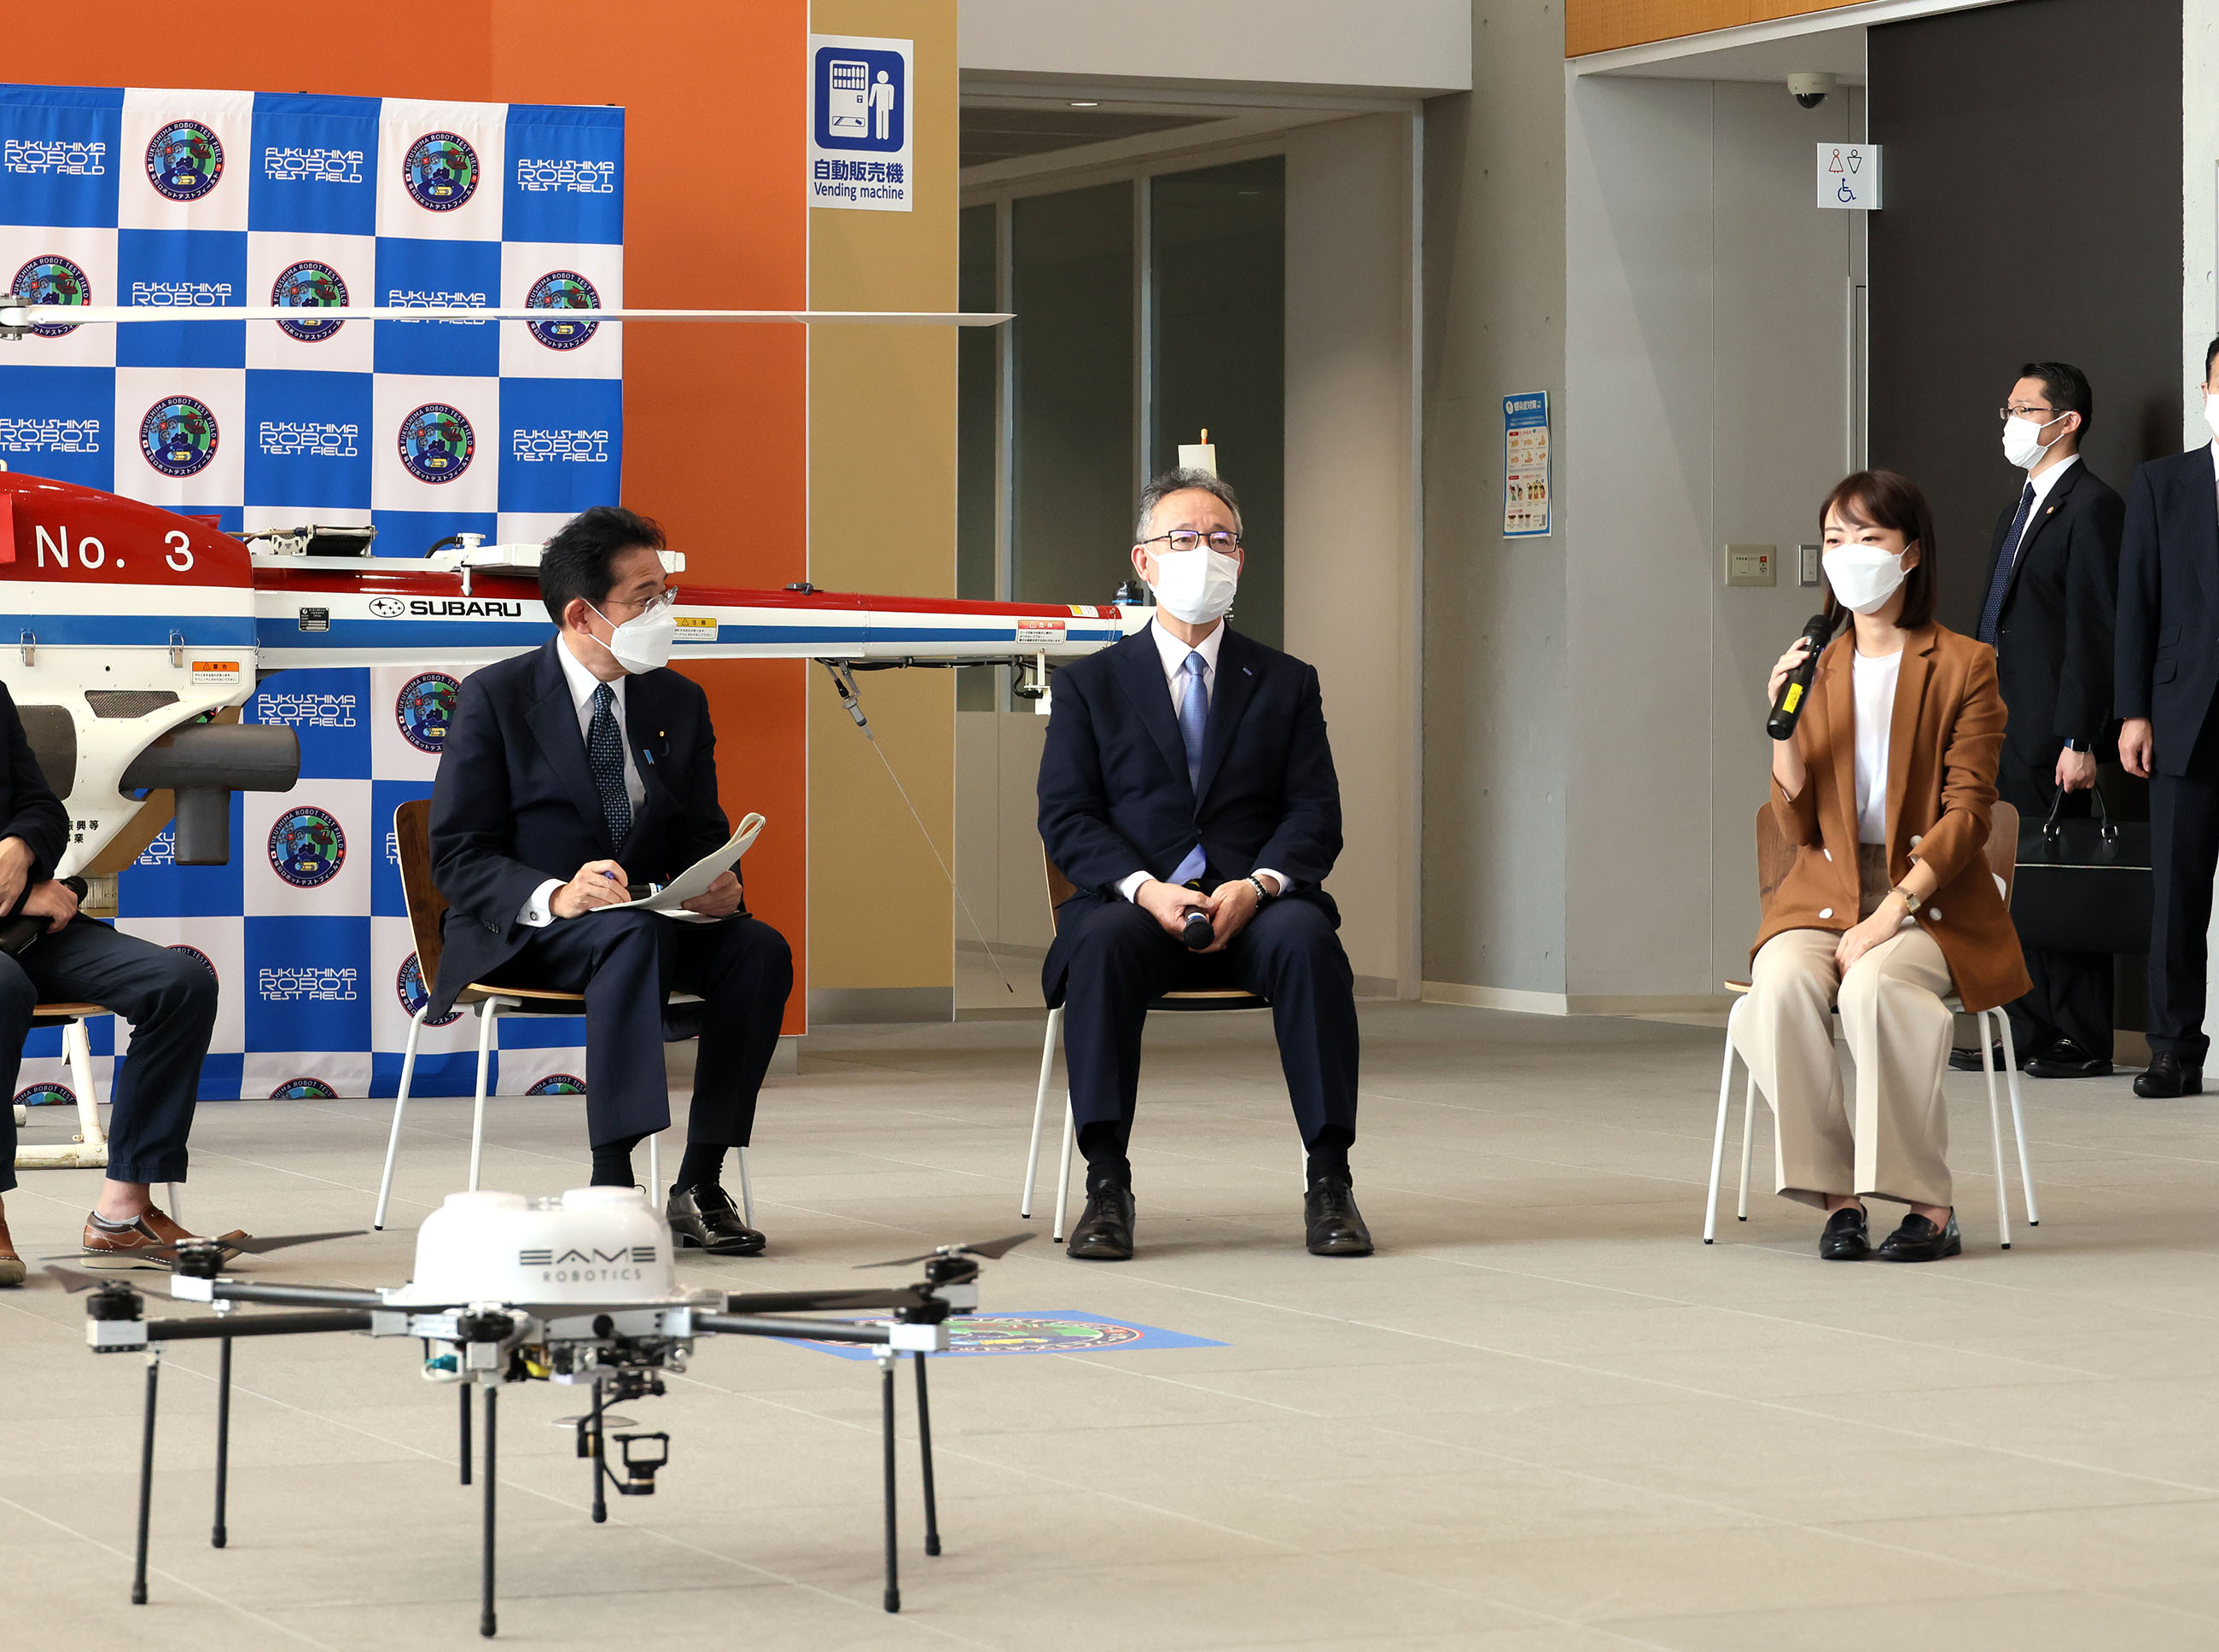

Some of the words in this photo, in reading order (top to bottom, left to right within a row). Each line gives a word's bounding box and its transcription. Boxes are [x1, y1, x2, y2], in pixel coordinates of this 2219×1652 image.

[5, 140, 106, 152] FUKUSHIMA
[148, 128, 172, 161] FUKUSHIMA
[200, 126, 215, 142] TEST
[213, 142, 222, 162] FIELD
[4, 150, 106, 166] ROBOT
[265, 147, 364, 160] FUKUSHIMA
[405, 137, 429, 171] FUKUSHIMA
[457, 138, 471, 152] TEST
[469, 154, 478, 174] FIELD
[4, 164, 51, 174] TEST
[56, 166, 105, 175] FIELD
[265, 157, 364, 173] ROBOT
[518, 159, 614, 171] FUKUSHIMA
[814, 159, 904, 183] 自動販売機
[265, 171, 309, 181] TEST
[315, 172, 362, 183] FIELD
[517, 169, 614, 183] ROBOT
[517, 182, 562, 191] TEST
[567, 183, 614, 193] FIELD
[814, 182, 857, 201] Vending
[860, 184, 904, 200] machine
[65, 261, 80, 276] TEST
[79, 276, 89, 298] FIELD
[273, 267, 297, 302] FUKUSHIMA
[324, 268, 340, 282] TEST
[338, 283, 347, 304] FIELD
[132, 282, 232, 293] FUKUSHIMA
[577, 277, 591, 291] TEST
[590, 292, 599, 309] FIEL
[132, 292, 232, 305] ROBOT
[389, 290, 486, 302] FUKUSHIMA
[142, 402, 166, 437] FUKUSHIMA
[194, 403, 209, 416] TEST
[207, 417, 217, 438] FIELD
[259, 422, 358, 433] FUKUSHIMA
[400, 410, 423, 444] FUKUSHIMA
[451, 410, 465, 423] TEST
[463, 425, 473, 445] FIELD
[514, 429, 608, 439] FUKUSHIMA
[0, 428, 99, 442] ROBOT
[259, 432, 358, 447] ROBOT
[0, 442, 44, 452] TEST
[51, 443, 99, 452] FIELD
[259, 445, 305, 455] TEST
[311, 446, 358, 457] FIELD
[513, 439, 608, 452] ROBOT
[513, 452, 556, 462] TEST
[562, 452, 608, 462] FIELD
[36, 526, 125, 569] No.
[164, 530, 195, 572] 3
[410, 601, 521, 616] SUBARU
[258, 694, 356, 704] FUKUSHIMA
[399, 679, 421, 713] FUKUSHIMA
[447, 679, 459, 691] TES
[258, 703, 356, 717] ROBOT
[258, 717, 304, 727] TEST
[309, 717, 356, 727] FIELD
[270, 813, 294, 848] FUKUSHIMA
[321, 813, 336, 827] TEST
[334, 828, 344, 848] FIELD
[68, 834, 84, 843] 業
[134, 855, 174, 865] EST
[193, 951, 207, 964] TEST
[259, 968, 357, 978] FUKUSHIMA
[259, 978, 357, 991] ROBOT
[259, 991, 302, 1000] TEST
[309, 991, 357, 1000] FIELD
[60, 1089, 73, 1102] TEST
[319, 1084, 333, 1097] TEST
[543, 1268, 642, 1282] ROBOTICS
